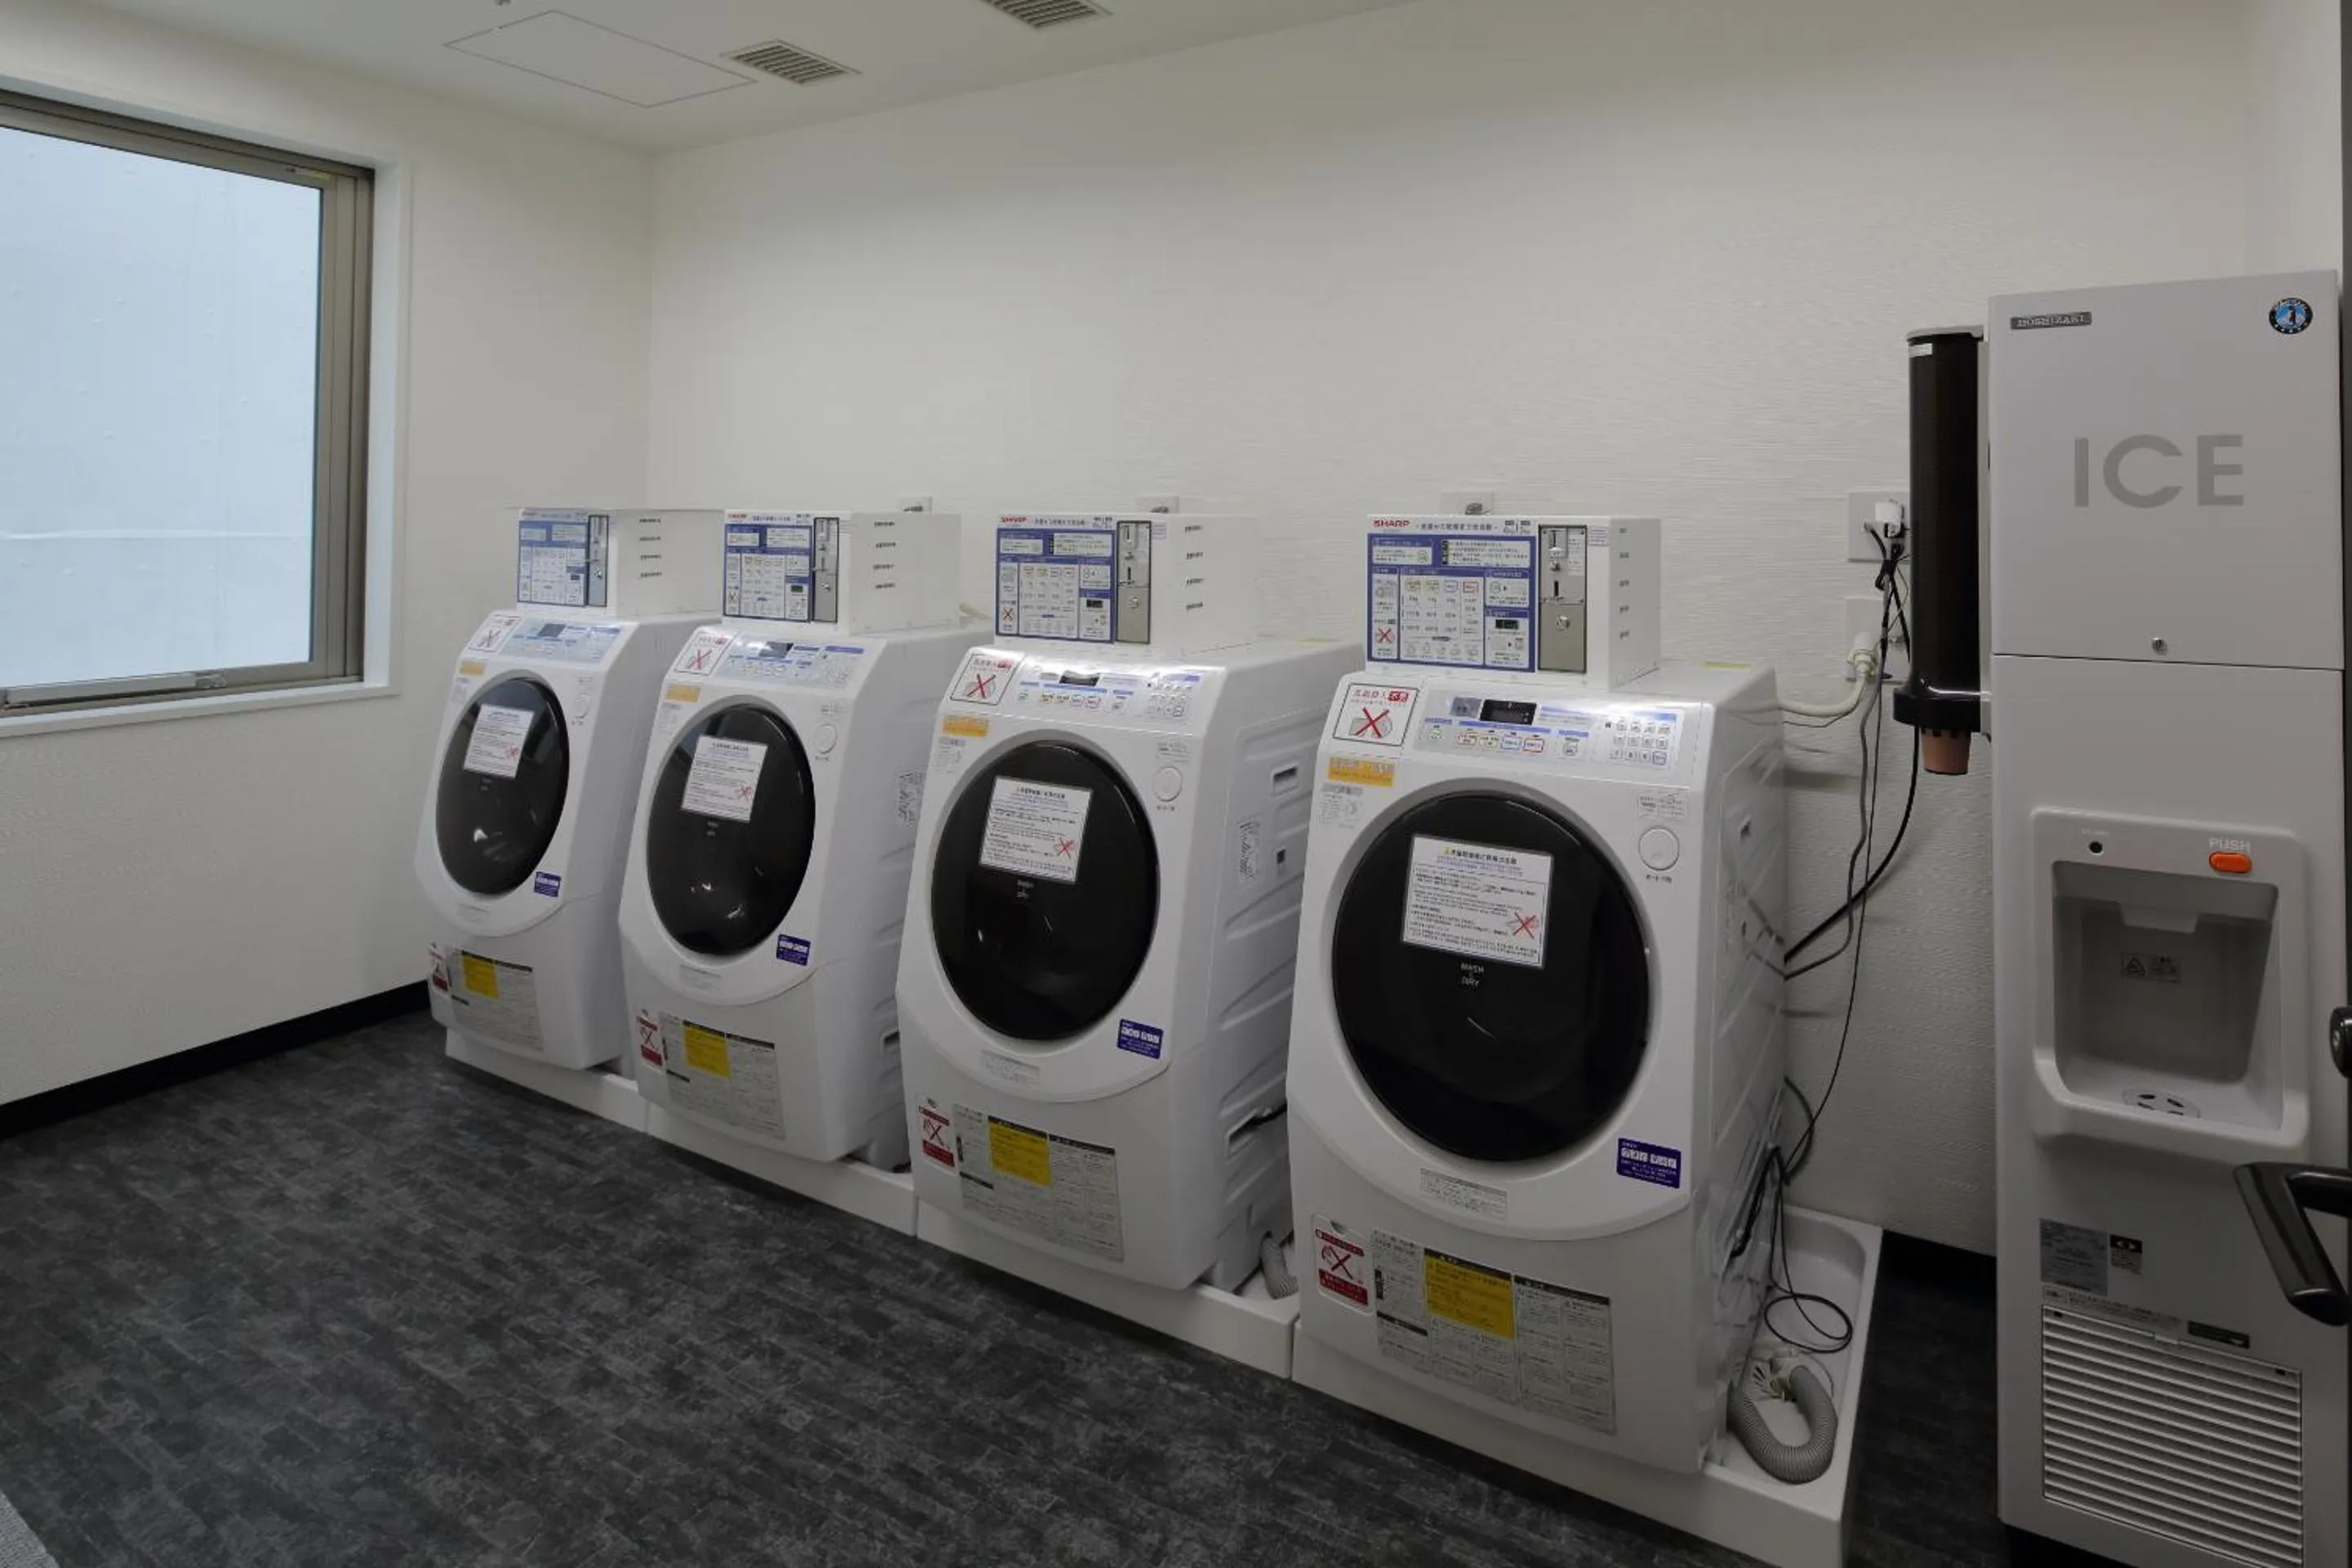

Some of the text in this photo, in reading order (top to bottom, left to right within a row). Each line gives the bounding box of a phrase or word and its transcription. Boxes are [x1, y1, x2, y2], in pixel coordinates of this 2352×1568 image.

[2074, 434, 2244, 509] ICE
[1373, 519, 1410, 528] SHARP
[2208, 837, 2251, 853] PUSH
